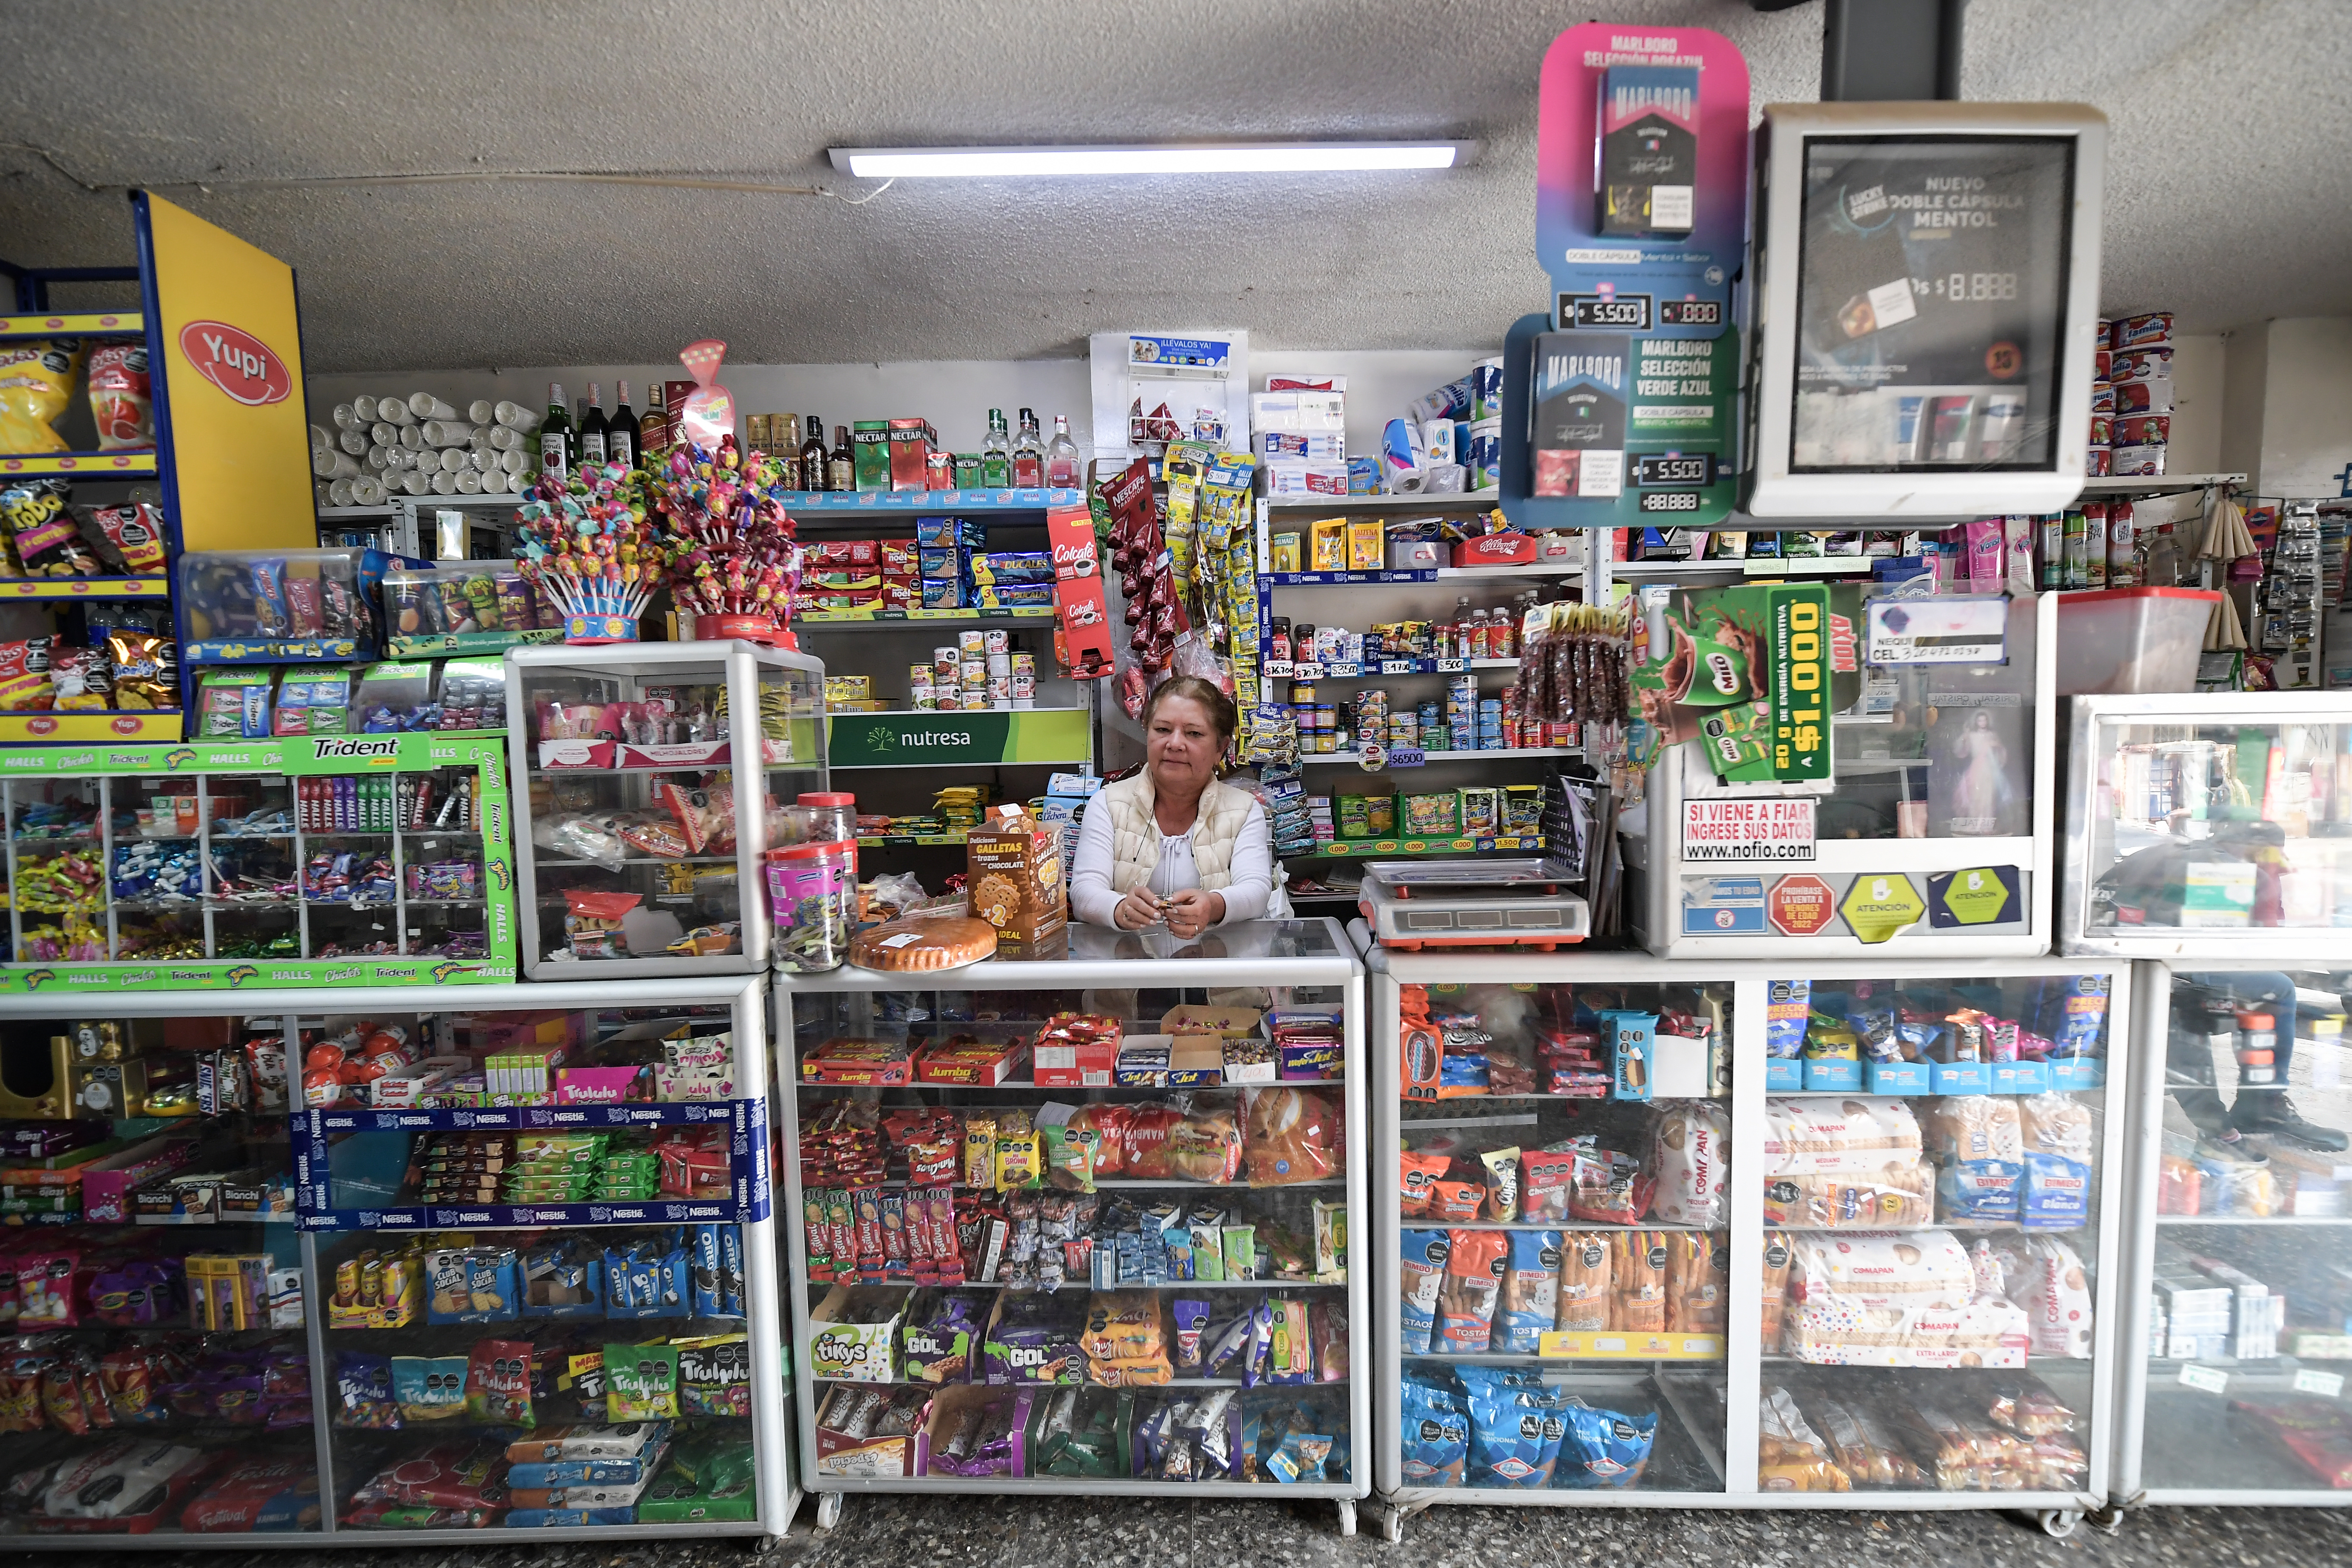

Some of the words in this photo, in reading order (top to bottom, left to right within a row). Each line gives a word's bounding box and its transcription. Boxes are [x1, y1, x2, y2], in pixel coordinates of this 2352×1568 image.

[1612, 35, 1677, 53] MARLBORO
[1616, 87, 1690, 120] MARLBORO
[1925, 177, 1986, 191] NUEVO
[1914, 212, 1998, 228] MENTOL
[2128, 320, 2165, 339] familia
[1161, 339, 1198, 349] ¡LLÉVALOS
[1642, 340, 1712, 357] MARLBORO
[202, 332, 266, 381] Yupi
[1547, 356, 1622, 390] MARLBORO
[1640, 357, 1711, 376] SELECCIÓN
[1636, 380, 1678, 396] VERDE
[1680, 380, 1712, 395] AZUL
[855, 432, 887, 444] NECTAR
[890, 430, 922, 441] NECTAR
[1015, 452, 1035, 460] NECTAR
[1350, 466, 1371, 476] familia
[1657, 461, 1702, 480] 5.500
[1054, 541, 1094, 563] Colcafé
[1479, 539, 1519, 553] Kellogg's
[1004, 559, 1048, 569] DUCALES
[1059, 566, 1073, 574] SUAVE
[892, 589, 911, 598] noel
[1014, 591, 1048, 599] DUCALES
[1069, 599, 1095, 617] Colcafé
[1778, 604, 1787, 659] NUTRITIVA
[1829, 613, 1857, 671] AXION
[1877, 637, 1913, 646] NEQUI
[1715, 655, 1734, 689] MILO
[1777, 662, 1788, 706] ENERGÍA
[1780, 708, 1788, 721] DE
[35, 720, 50, 730] Yupi
[117, 719, 136, 730] Yupi
[901, 730, 971, 747] nutresa
[313, 738, 399, 759] Trident
[1723, 739, 1737, 760] MILO
[1776, 744, 1789, 769] 20
[1800, 756, 1813, 768] A
[1044, 811, 1068, 822] Lechera
[1690, 804, 1704, 821] SI
[1709, 804, 1754, 821] VIENE
[1759, 804, 1769, 820] A
[1774, 803, 1809, 820] FIAR
[490, 801, 502, 844] Trident
[1688, 824, 1740, 841] INGRESE
[1743, 823, 1768, 839] SUS
[1773, 822, 1812, 840] DATOS
[976, 842, 1022, 854] GALLETAS
[1036, 844, 1059, 864] GALLETAS
[1688, 841, 1812, 859] www.nofio.com
[988, 861, 1024, 869] CHOCOLATE
[1781, 886, 1824, 895] PROHÍBASE
[1955, 889, 1997, 901] ATENCIÓN
[1781, 896, 1790, 904] LA
[1784, 904, 1820, 912] MENORES
[1856, 901, 1911, 913] ATENCIÓN
[999, 931, 1021, 939] IDEAL
[374, 968, 417, 977] Trident
[1288, 1056, 1310, 1067] Wafer
[838, 1073, 871, 1082] Jumbo
[929, 1065, 972, 1078] Jumbo
[1119, 1071, 1141, 1083] Jet
[1171, 1071, 1198, 1083] Jet
[564, 1084, 617, 1099] Trululu
[1809, 1124, 1846, 1133] COMAPAN
[1005, 1157, 1027, 1165] BROWN
[2044, 1177, 2082, 1189] BIMBO
[225, 1190, 259, 1200] Bianchi
[1527, 1184, 1565, 1197] Chocoso
[137, 1194, 172, 1203] Bianchi
[2042, 1199, 2080, 1210] Blanco
[702, 1232, 714, 1271] OREO
[724, 1233, 736, 1273] OREO
[1403, 1260, 1431, 1273] BIMBO
[437, 1270, 455, 1280] CLUB
[474, 1270, 491, 1280] CLUB
[1518, 1271, 1546, 1279] BIMBO
[611, 1267, 623, 1301] OREO
[1468, 1277, 1494, 1288] BIMBO
[2047, 1258, 2058, 1323] COMAPAN
[1914, 1322, 1959, 1331] COMAPAN
[908, 1337, 939, 1353] GOL
[1010, 1349, 1048, 1367] GOL
[680, 1360, 750, 1380] Trululu
[612, 1375, 669, 1391] Trululu
